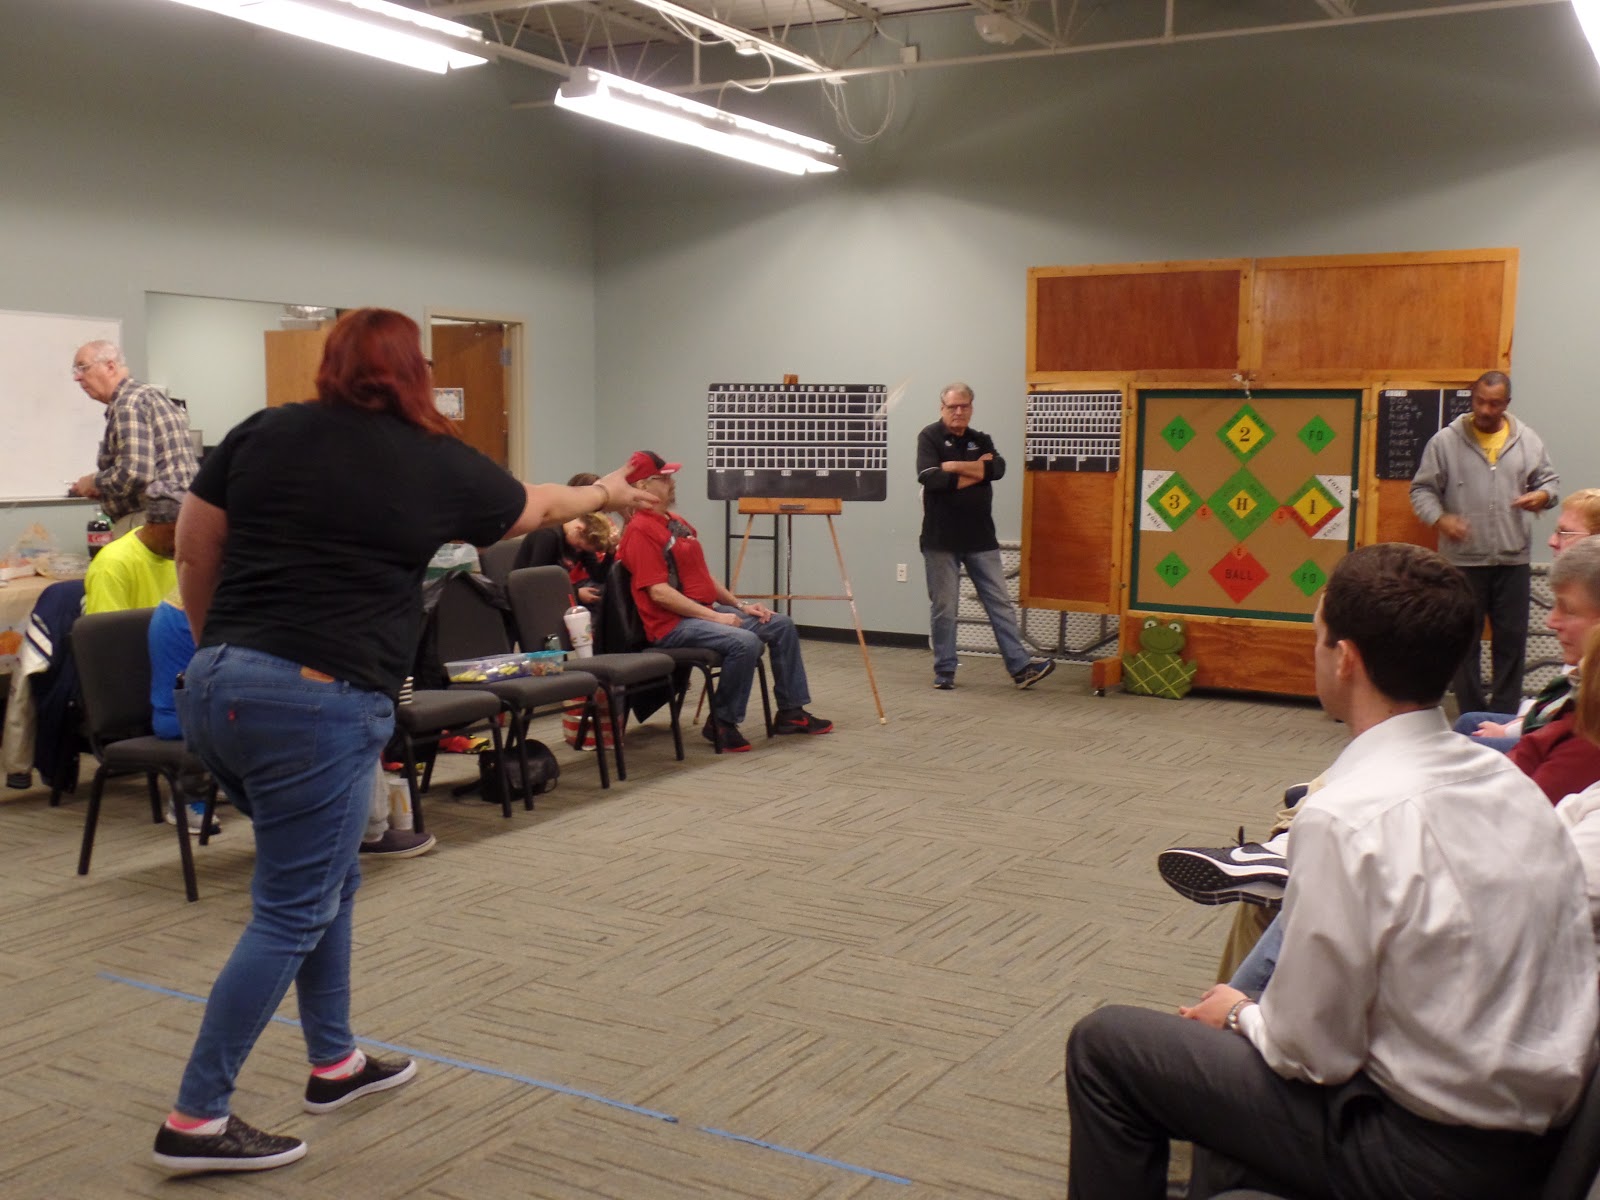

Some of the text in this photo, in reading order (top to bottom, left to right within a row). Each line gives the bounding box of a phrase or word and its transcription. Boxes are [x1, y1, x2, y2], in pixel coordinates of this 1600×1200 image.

[1170, 429, 1184, 440] FO
[1239, 426, 1251, 442] 2
[1308, 430, 1323, 441] FO
[1327, 477, 1344, 495] FOUL
[1169, 494, 1180, 509] 3
[1236, 497, 1248, 511] H
[1310, 499, 1316, 515] 1
[1146, 512, 1162, 529] FOUL
[1165, 564, 1179, 576] FO
[1225, 569, 1253, 581] BALL
[1301, 572, 1317, 583] FO
